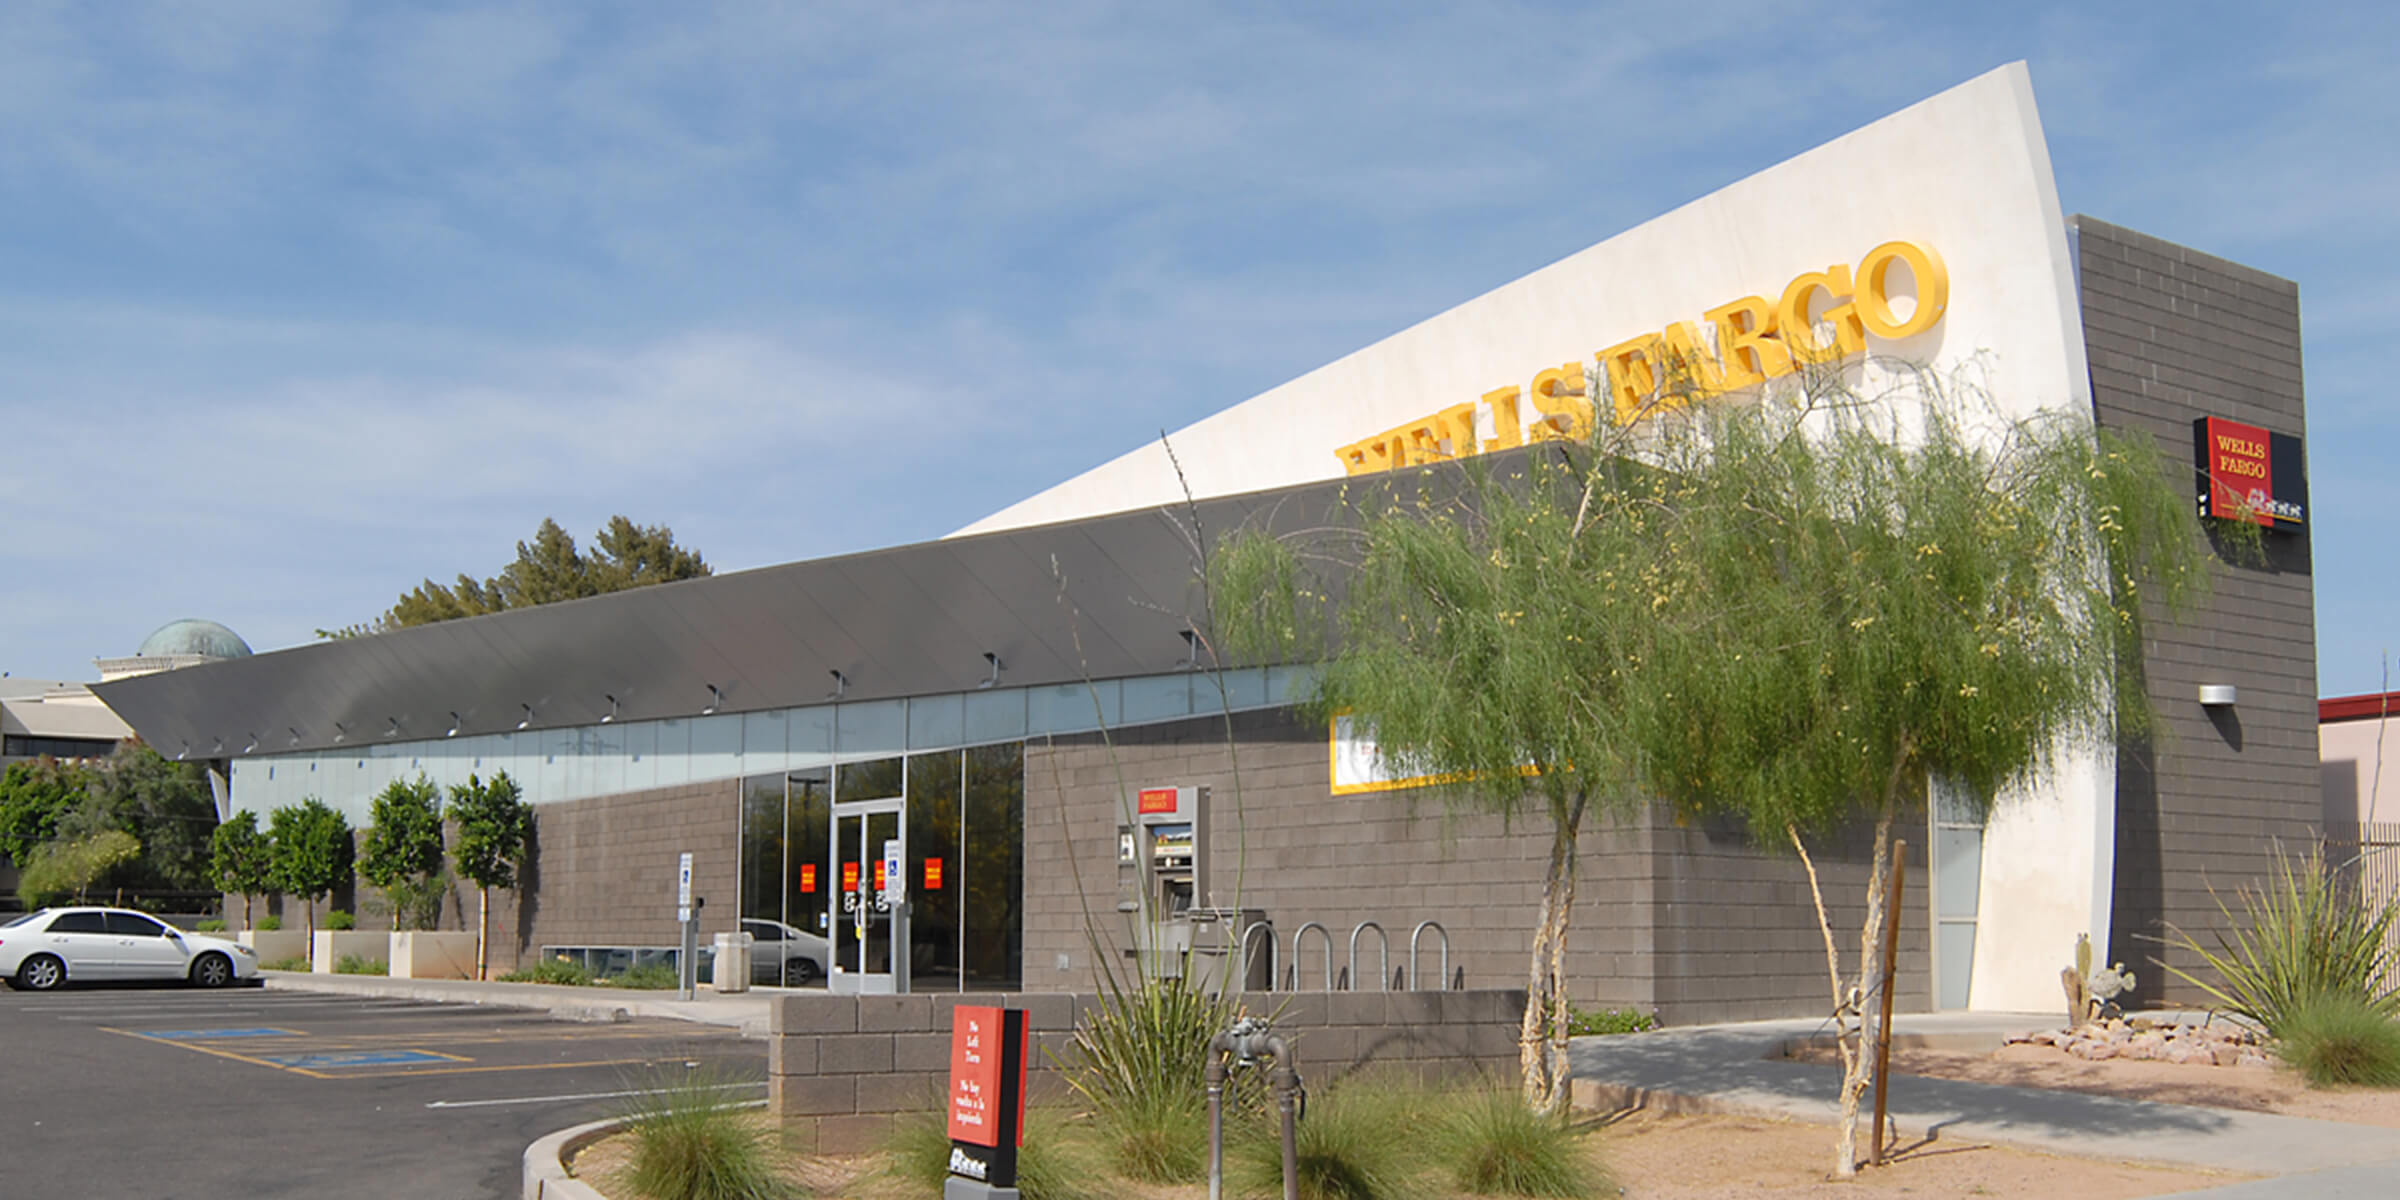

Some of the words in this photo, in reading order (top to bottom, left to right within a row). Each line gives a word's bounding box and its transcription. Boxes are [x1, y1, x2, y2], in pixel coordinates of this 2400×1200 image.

[1594, 240, 1949, 427] FARGO
[2217, 435, 2265, 459] WELLS
[2219, 455, 2265, 479] FARGO
